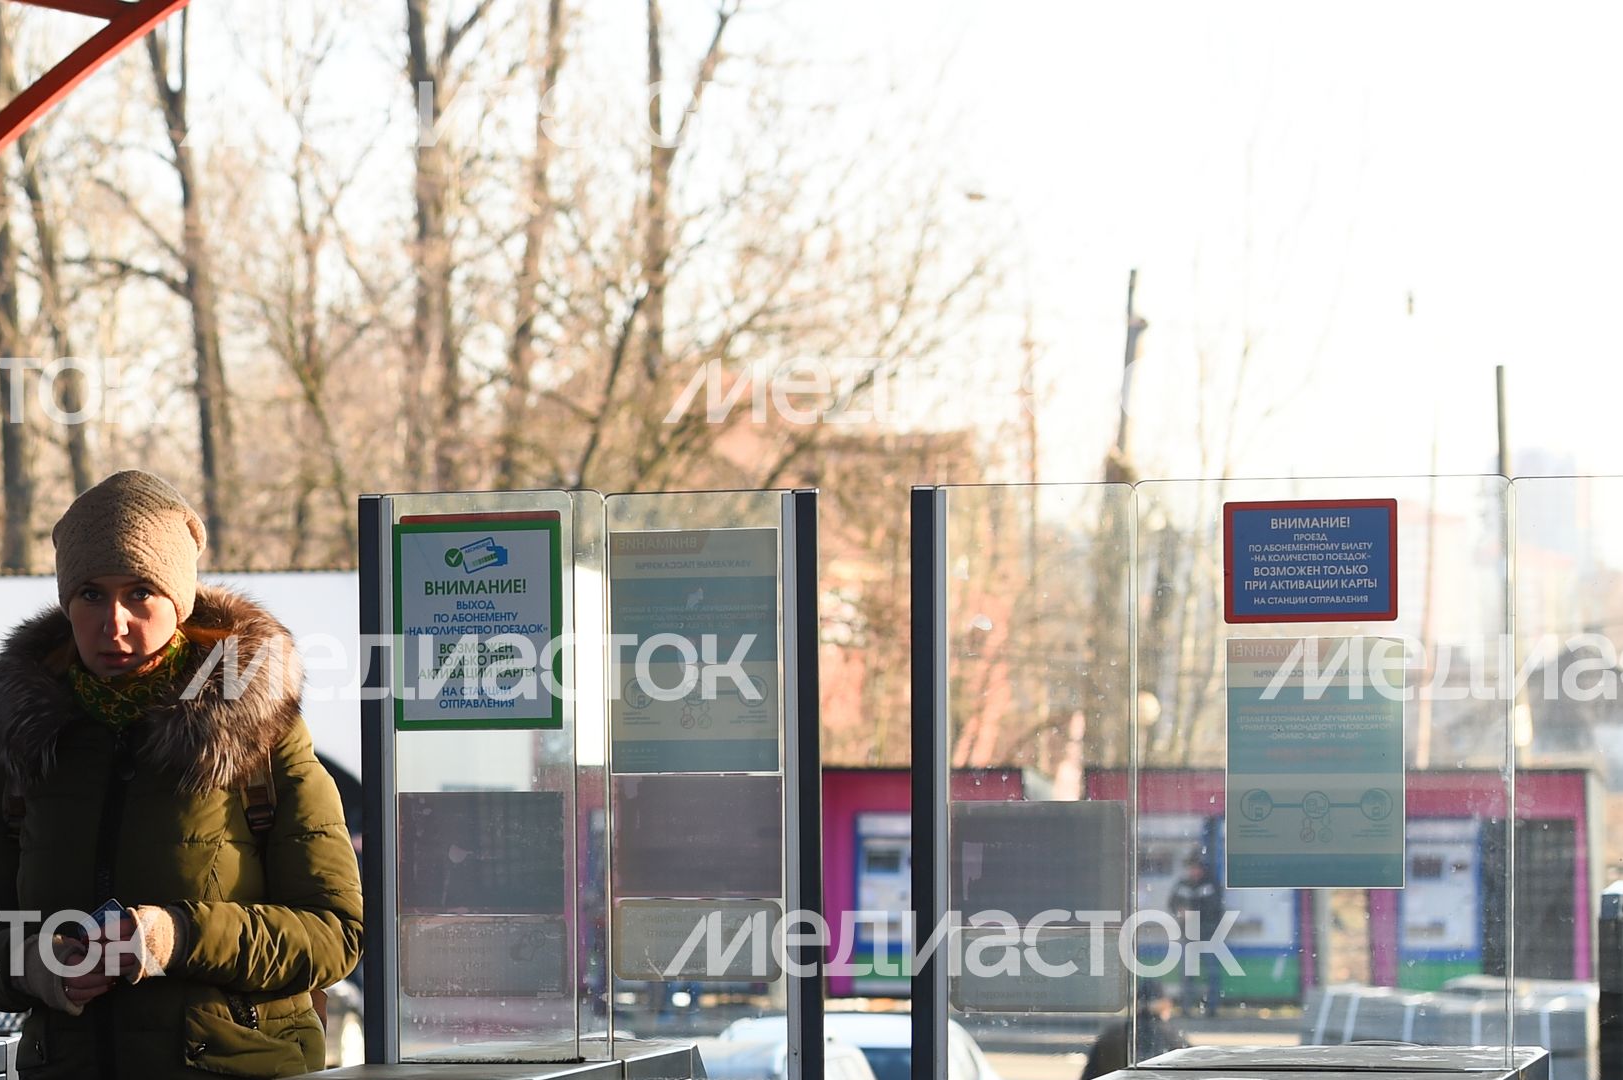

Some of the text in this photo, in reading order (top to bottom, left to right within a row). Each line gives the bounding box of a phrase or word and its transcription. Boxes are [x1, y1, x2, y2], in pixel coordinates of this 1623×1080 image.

[1271, 517, 1350, 529] ВНИМАНИЕ!
[1294, 533, 1328, 542] ПРОЕЗД
[1264, 543, 1339, 552] АБОНЕМЕНТНОМУ
[1254, 565, 1368, 576] ВОЗМОЖЕН ТОЛЬКО
[425, 579, 526, 596] ВНИМАНИЕ!
[1245, 579, 1377, 590] ПРИ АКТИВАЦИИ КАРТЫ
[456, 601, 495, 610] ВЫХОД
[1254, 597, 1265, 605] НА
[434, 612, 518, 623] ПО АБОНЕМЕНТУ
[426, 625, 492, 634] КОЛИЧЕСТВО
[440, 643, 512, 654] ВОЗМОЖЕН
[438, 655, 514, 666] ТОЛЬКО ПРИ
[418, 668, 492, 680] АКТИВАЦИИ
[442, 687, 457, 696] НА
[440, 699, 514, 709] ОТПРАВЛЕНИЯ
